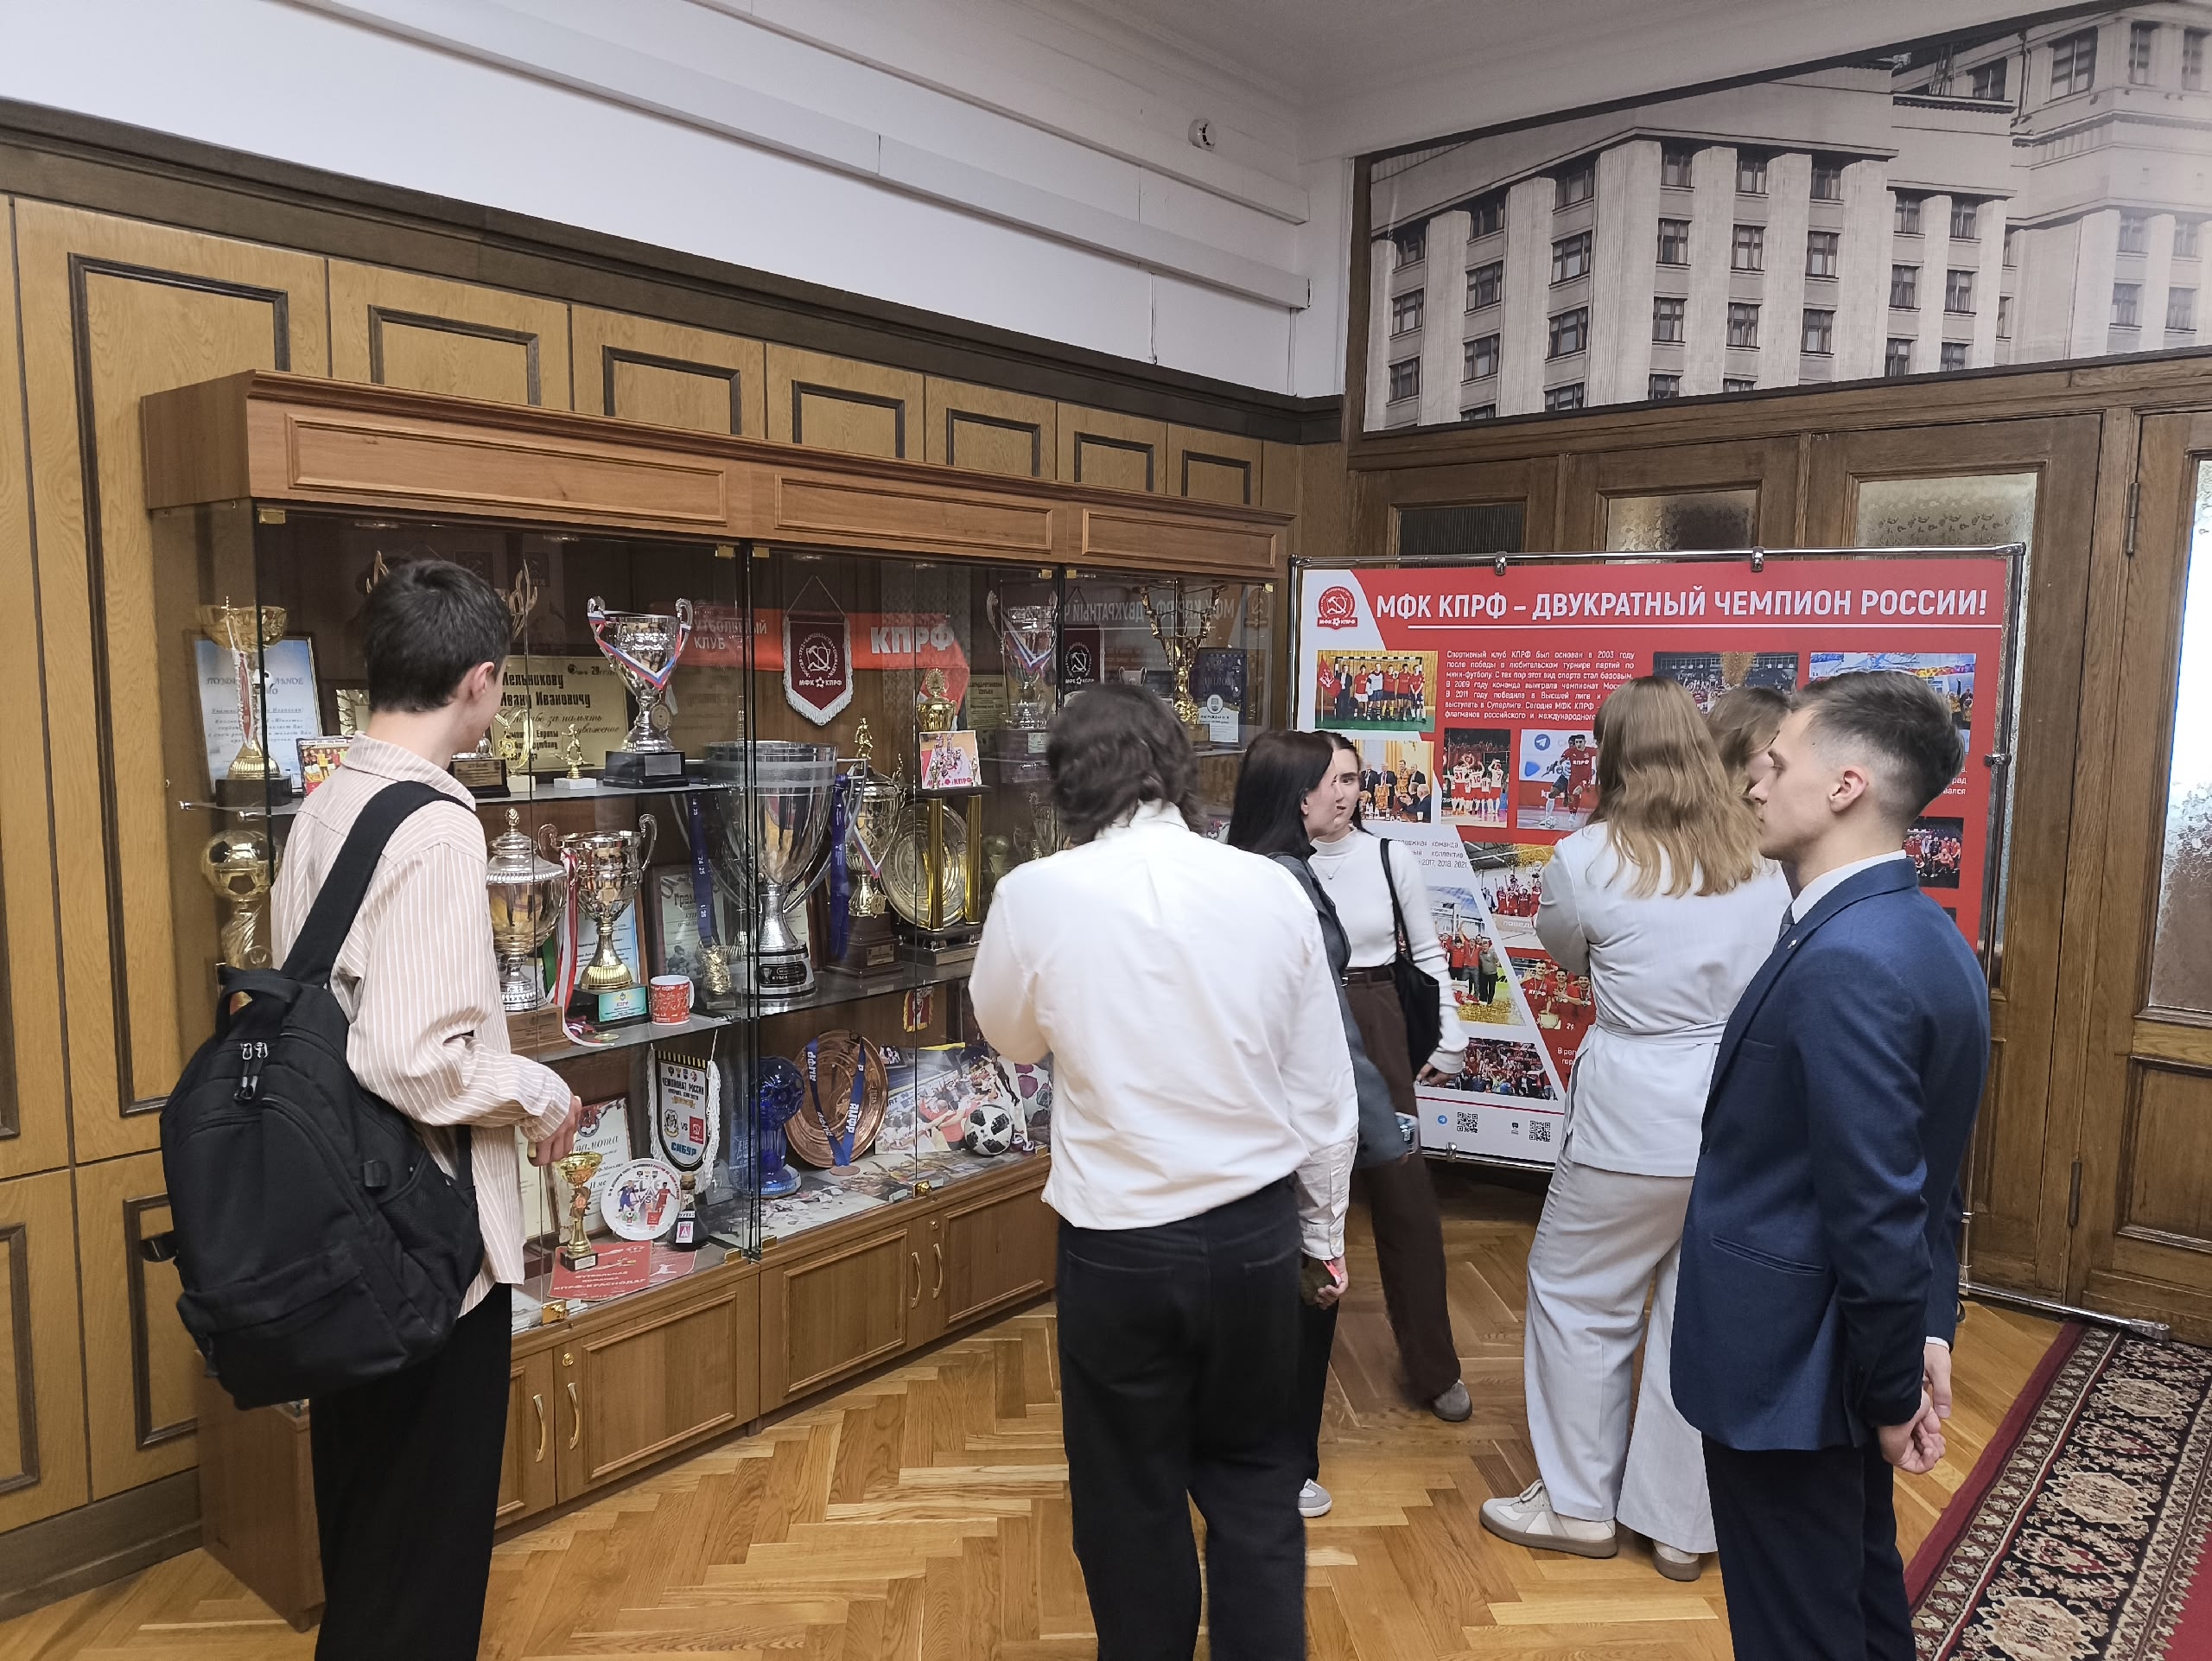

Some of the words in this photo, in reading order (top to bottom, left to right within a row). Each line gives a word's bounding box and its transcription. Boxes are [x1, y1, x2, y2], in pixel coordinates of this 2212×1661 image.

[1376, 594, 1432, 620] МФК
[1439, 592, 1508, 620] КПРФ
[1531, 585, 1707, 620] ДВУКРАТНЫЙ
[1713, 589, 1852, 616] ЧЕМПИОН
[1859, 589, 1987, 616] РОССИИ!
[694, 619, 767, 634] УТБОЛЬНЫЙ
[694, 636, 726, 650] КЛУБ
[870, 623, 955, 654] КПРФ
[1446, 650, 1486, 659] Спортивный
[1491, 650, 1507, 659] клуб
[1535, 650, 1550, 659] был
[1595, 660, 1620, 670] партий
[1446, 671, 1493, 680] мини-футболу.
[536, 691, 591, 708] Ивановичу
[1445, 702, 1478, 710] выступать
[1487, 701, 1522, 710] Суперлиге.
[680, 1121, 689, 1131] VS
[671, 1141, 697, 1157] СИБУР
[638, 1194, 652, 1204] VS
[553, 1278, 646, 1290] КПРФ-КРАСНОДАР
